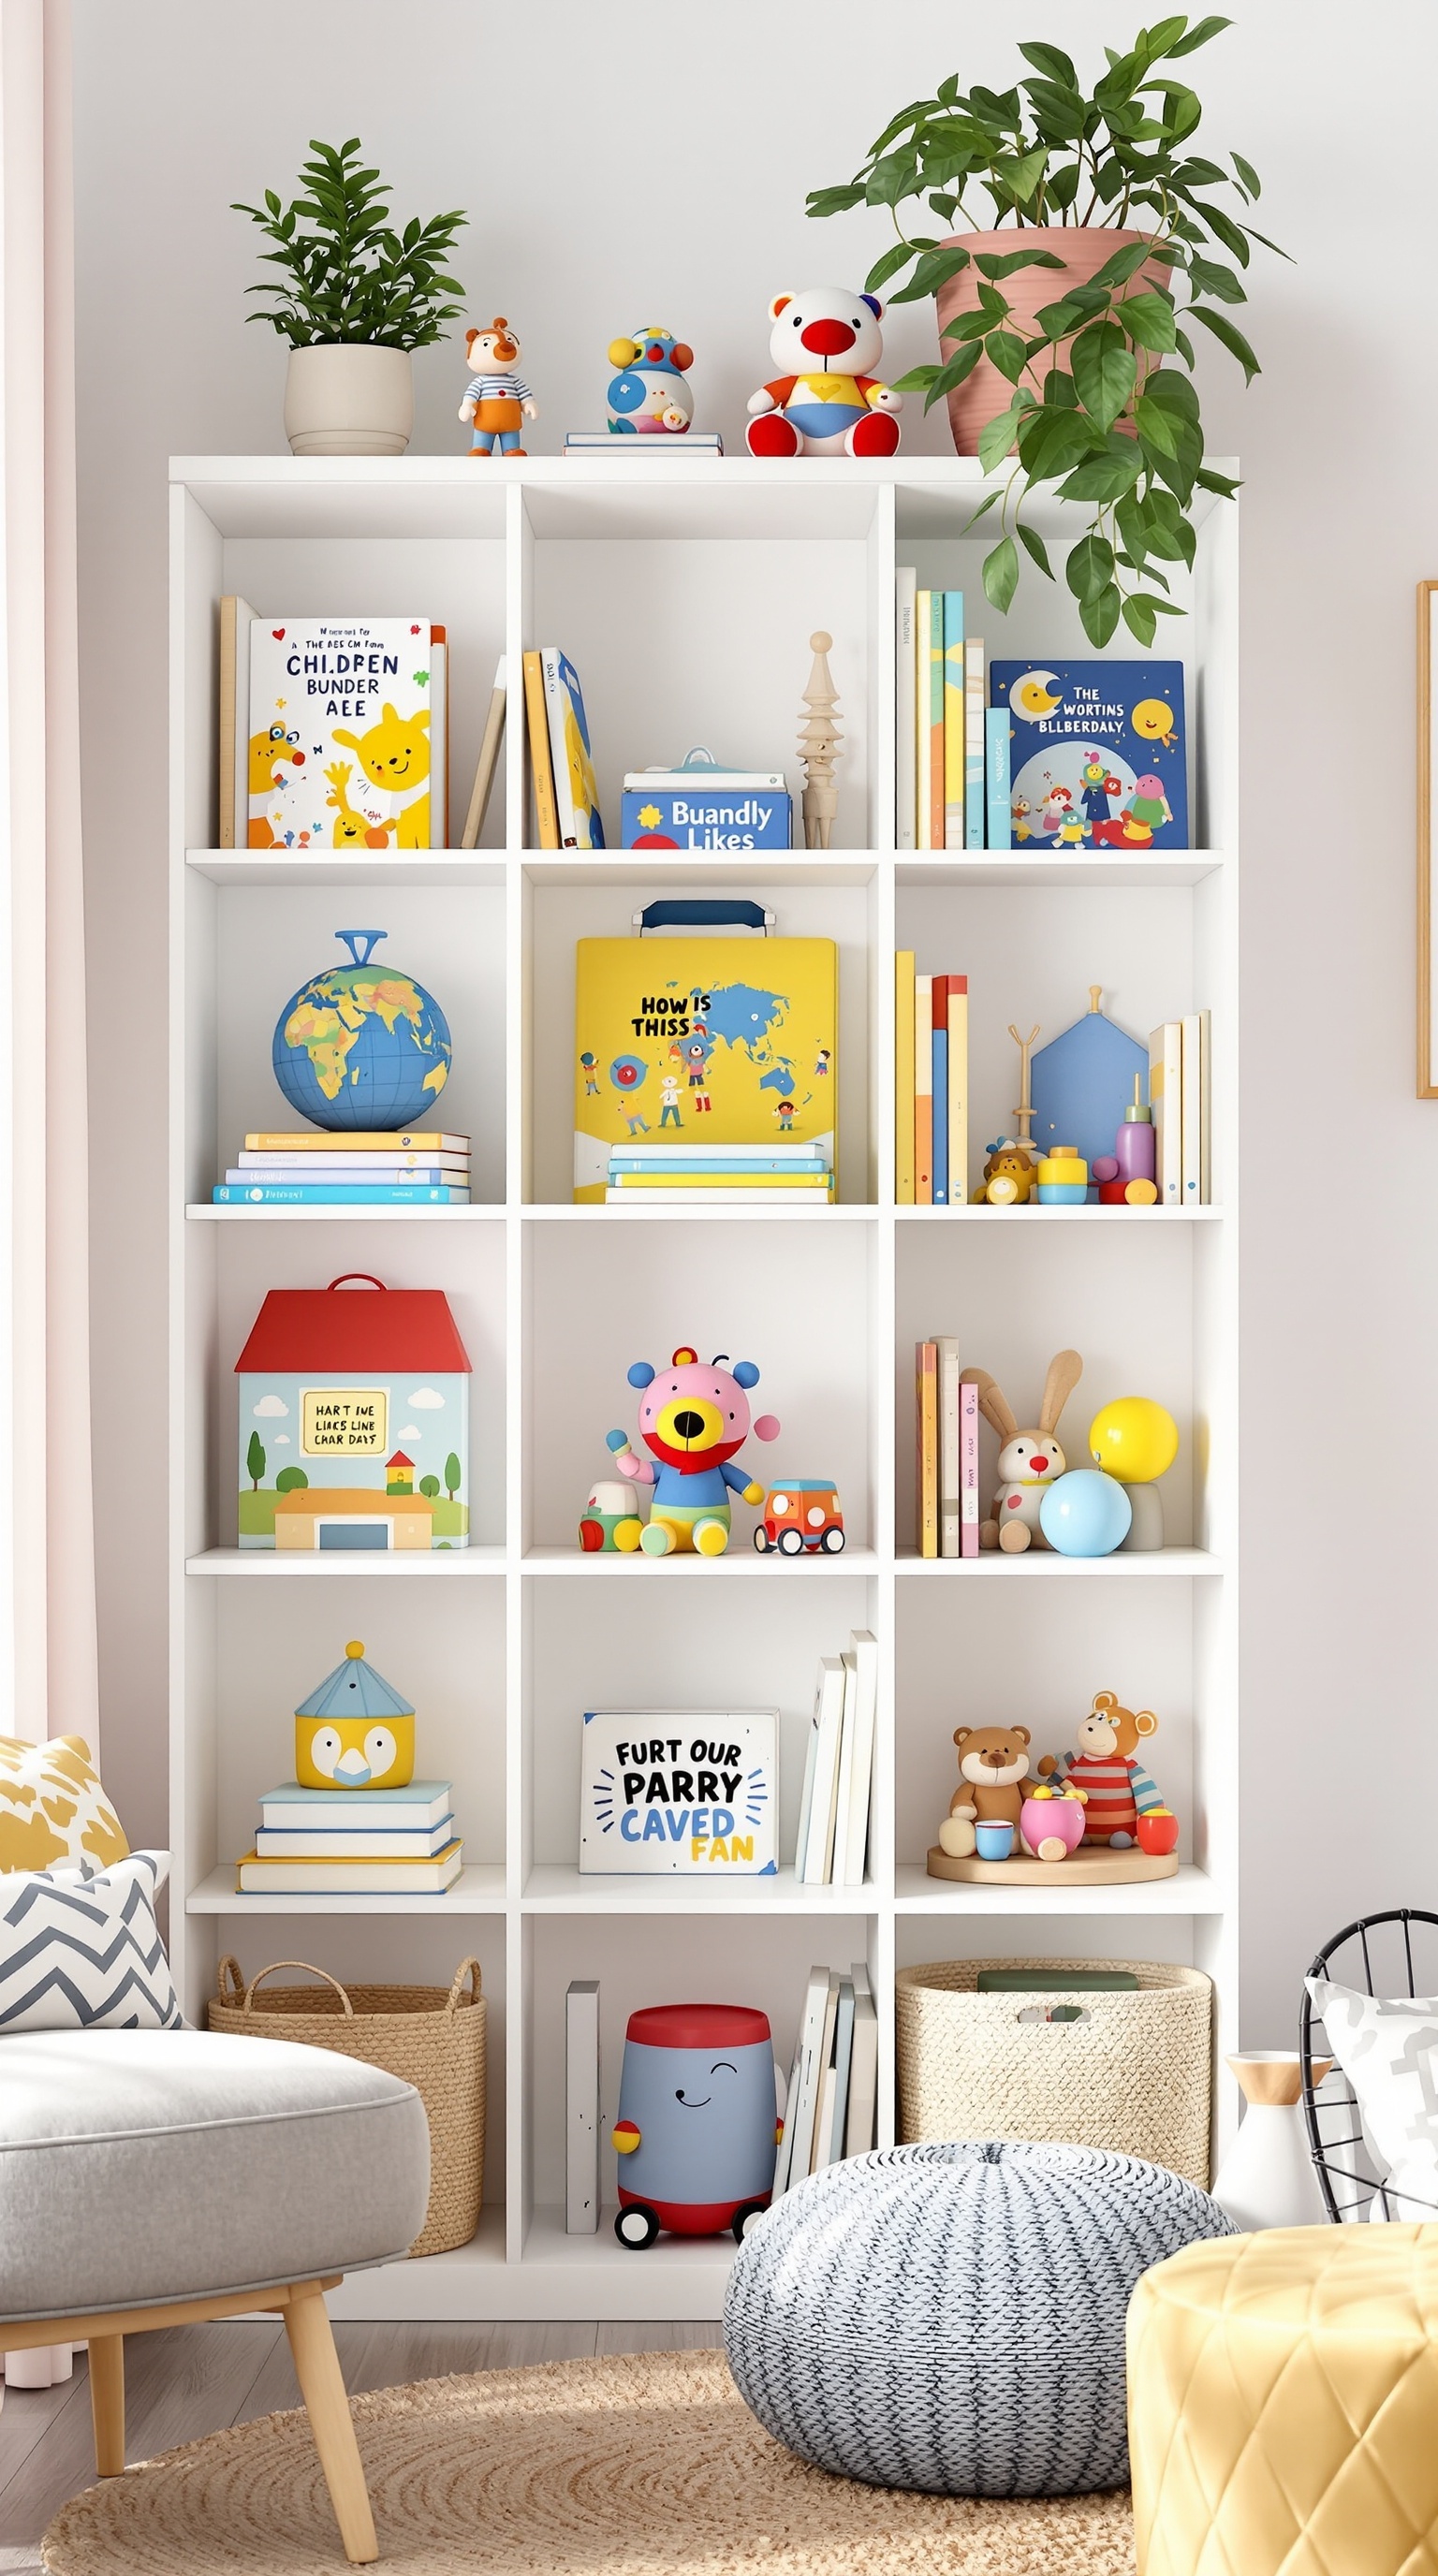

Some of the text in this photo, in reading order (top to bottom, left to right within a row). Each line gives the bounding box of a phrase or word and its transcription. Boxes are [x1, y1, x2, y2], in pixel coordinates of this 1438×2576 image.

[306, 640, 324, 649] THE
[307, 679, 379, 695] BUNDER
[1073, 686, 1100, 700] THE
[326, 700, 366, 717] AEE
[1064, 704, 1124, 717] WORTINS
[672, 800, 773, 831] Buandly
[688, 827, 756, 850] Likes
[641, 995, 712, 1015] HOW IS
[631, 1018, 690, 1036] THISS
[615, 1739, 741, 1766] FURT OUR
[624, 1770, 743, 1805] PARRY
[620, 1808, 735, 1842] CAVED
[690, 1836, 754, 1862] FAN
